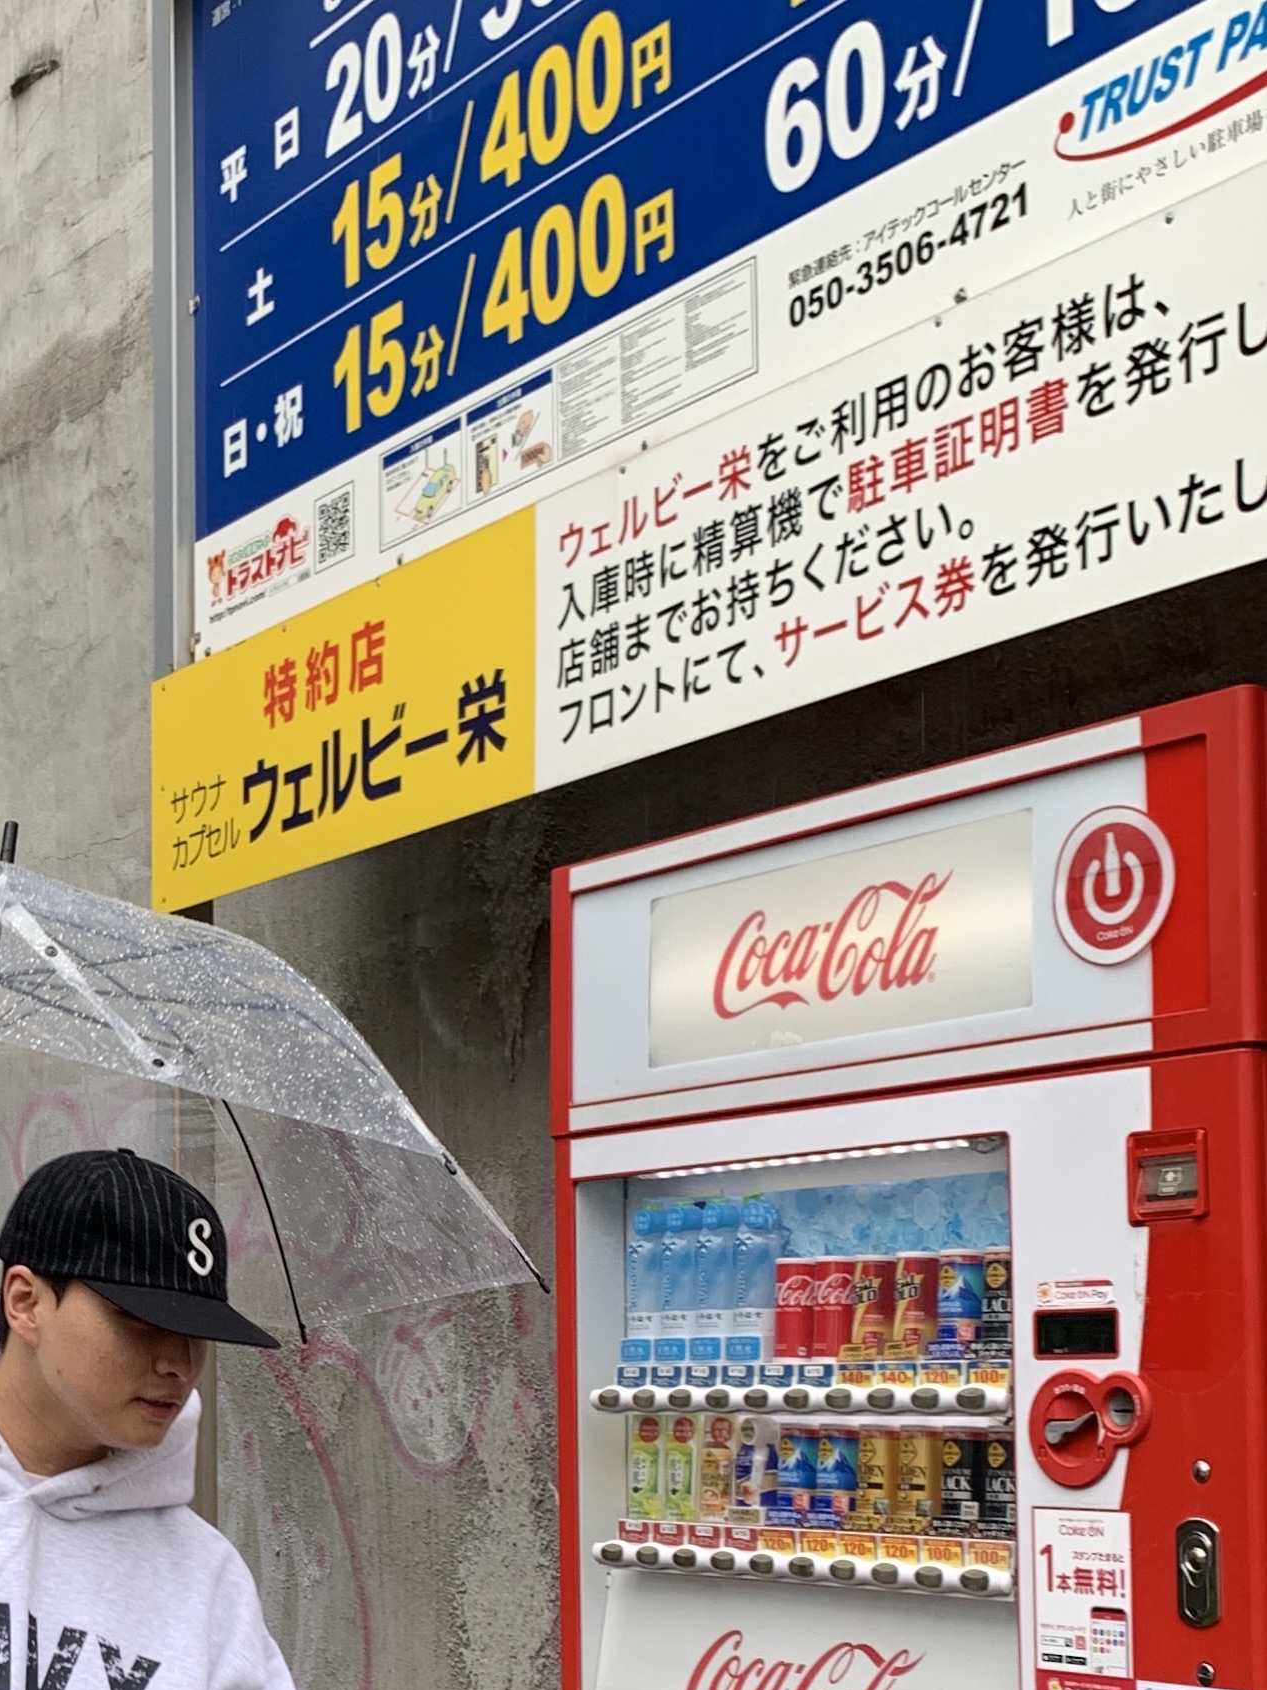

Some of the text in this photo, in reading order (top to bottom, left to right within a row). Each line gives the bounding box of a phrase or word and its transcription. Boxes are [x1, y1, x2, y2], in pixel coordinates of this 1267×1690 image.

[1078, 28, 1215, 142] TRUST
[246, 10, 672, 326] 土 15分/400円
[1067, 108, 1267, 221] 人と街にやさしい駐車場
[223, 384, 303, 479] 日・祝
[334, 174, 675, 434] 15分/400円
[789, 181, 1028, 328] 050-3506-4721
[559, 273, 1171, 568] ウェルビー栄をご利用のお客様は、
[557, 504, 974, 689] 店舗までお持ちください。
[263, 620, 386, 729] 特約店
[171, 775, 227, 825] サウナ
[243, 669, 508, 843] ウェルビー栄
[172, 817, 241, 871] カプセル
[713, 868, 954, 1020] Coca-Cola
[187, 1217, 215, 1277] S
